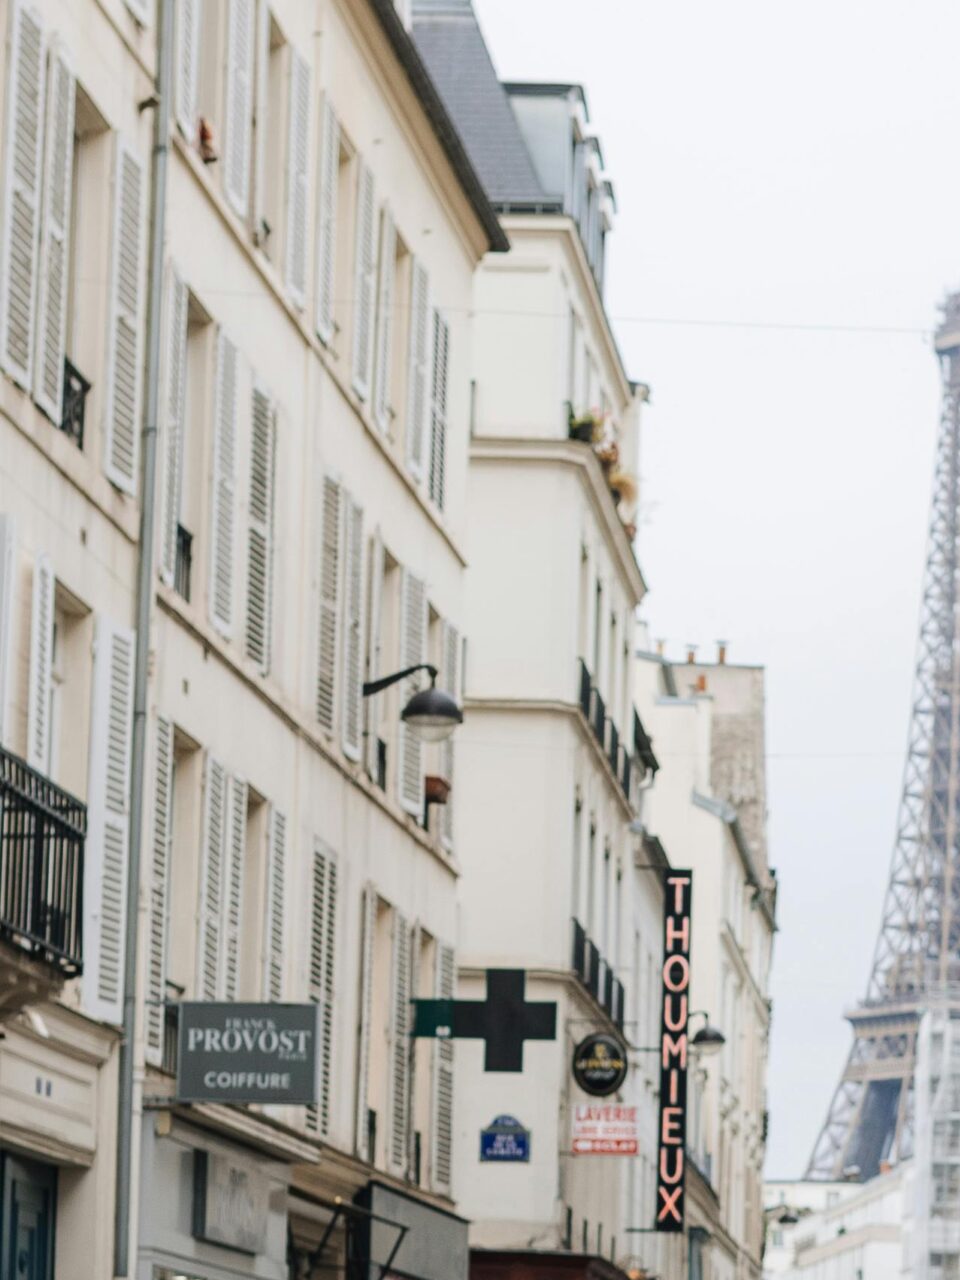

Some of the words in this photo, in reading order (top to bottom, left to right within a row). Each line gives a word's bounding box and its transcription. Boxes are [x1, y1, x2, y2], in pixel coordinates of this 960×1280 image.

[187, 1027, 313, 1053] PROVOST
[658, 877, 690, 1222] THOUMIEUX
[203, 1070, 291, 1090] COIFFURE
[576, 1104, 637, 1121] LAVERIE
